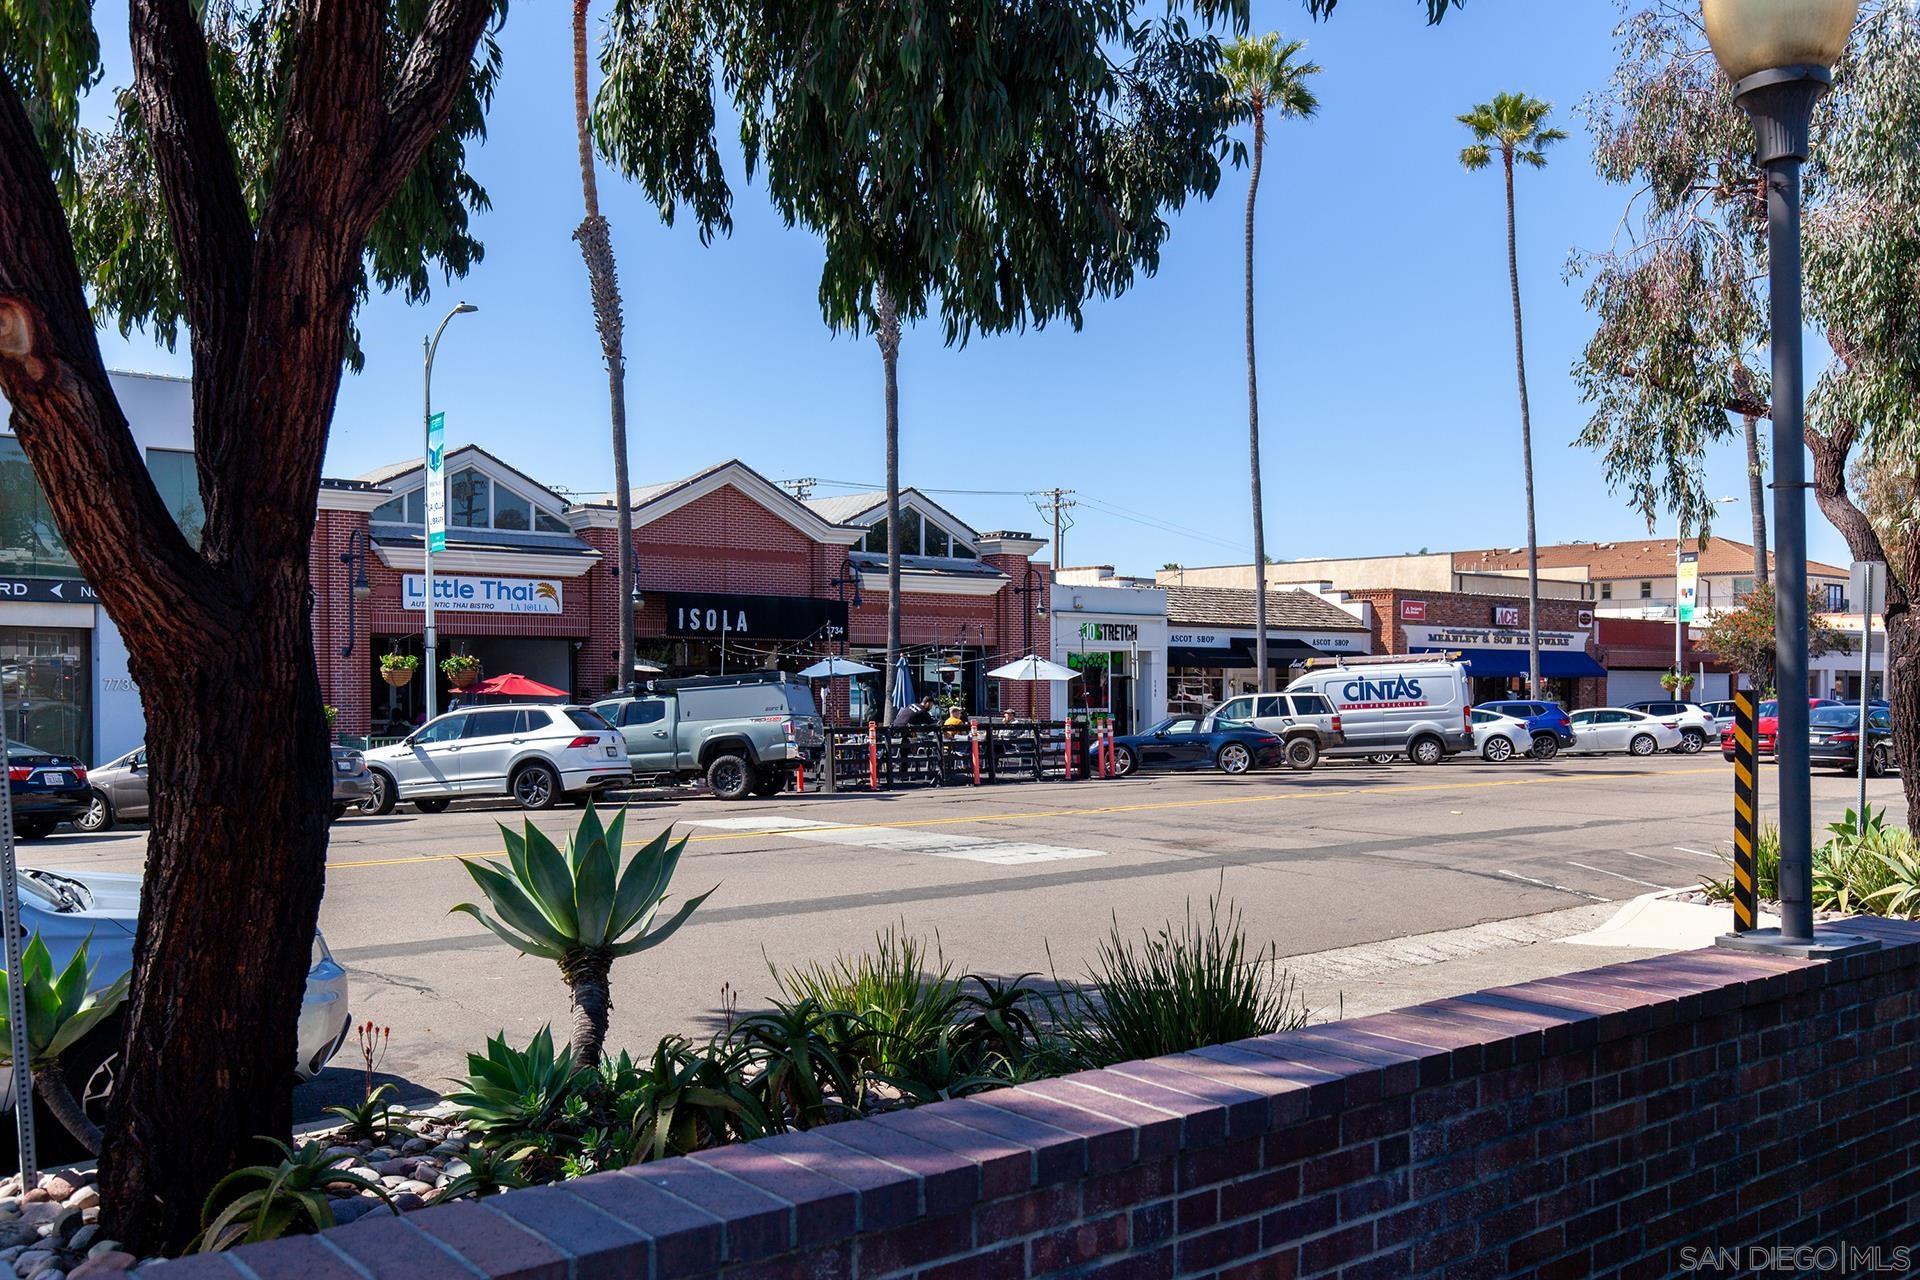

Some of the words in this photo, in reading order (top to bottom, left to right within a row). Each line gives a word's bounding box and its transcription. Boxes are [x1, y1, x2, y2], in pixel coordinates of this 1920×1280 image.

[408, 577, 474, 599] Little
[480, 580, 534, 601] Thai
[510, 603, 521, 611] LA
[678, 607, 748, 632] ISOLA
[1498, 609, 1517, 624] ACE
[1170, 635, 1192, 643] ASCOT
[1197, 635, 1215, 643] SHOP
[1312, 638, 1331, 646] ASCOT
[1334, 639, 1350, 647] SHOP
[1428, 633, 1478, 643] MEANLEY
[1482, 635, 1490, 644] &
[1493, 635, 1513, 644] SON
[1516, 636, 1570, 646] HADWARE
